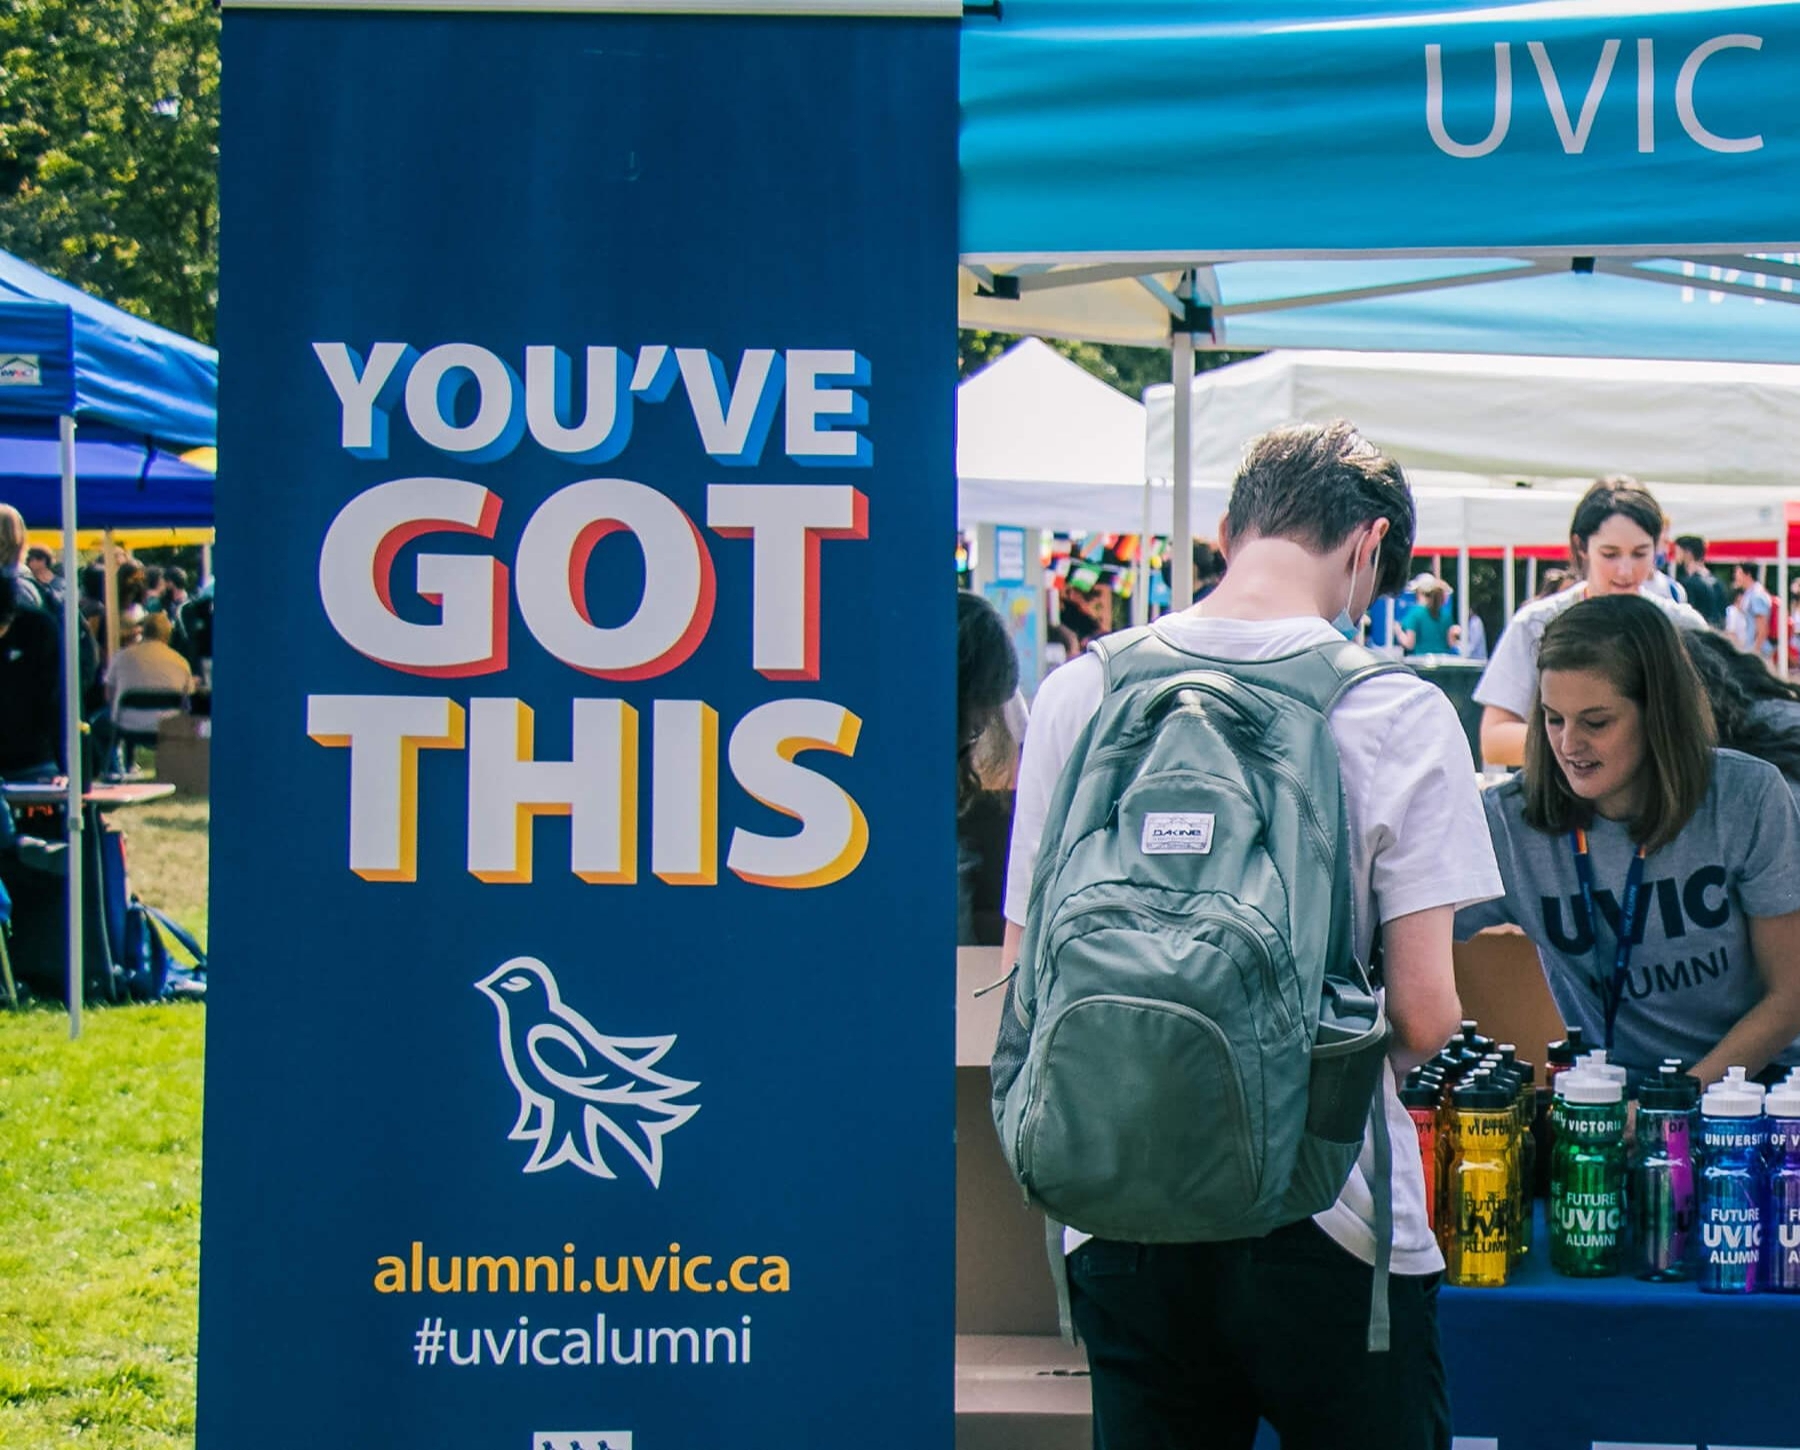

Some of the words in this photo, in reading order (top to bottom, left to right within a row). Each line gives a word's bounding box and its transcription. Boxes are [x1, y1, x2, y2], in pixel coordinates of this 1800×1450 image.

[1424, 34, 1763, 158] UVIC
[312, 342, 870, 466] YOU'VE
[319, 477, 869, 680] GOT
[307, 695, 869, 889] THIS
[1152, 829, 1202, 837] DAKINE
[1541, 864, 1730, 956] UVIC
[1586, 946, 1730, 1004] UMNI
[1770, 1133, 1787, 1146] OF
[1561, 1207, 1620, 1232] UVIC
[1566, 1191, 1617, 1207] FUTURE
[1711, 1207, 1760, 1223] FUTURE
[1565, 1233, 1617, 1248] ALUMNI
[1703, 1222, 1762, 1248] UVIC
[374, 1241, 790, 1293] alumni.uvic.ca
[414, 1313, 751, 1365] #uvicalumni
